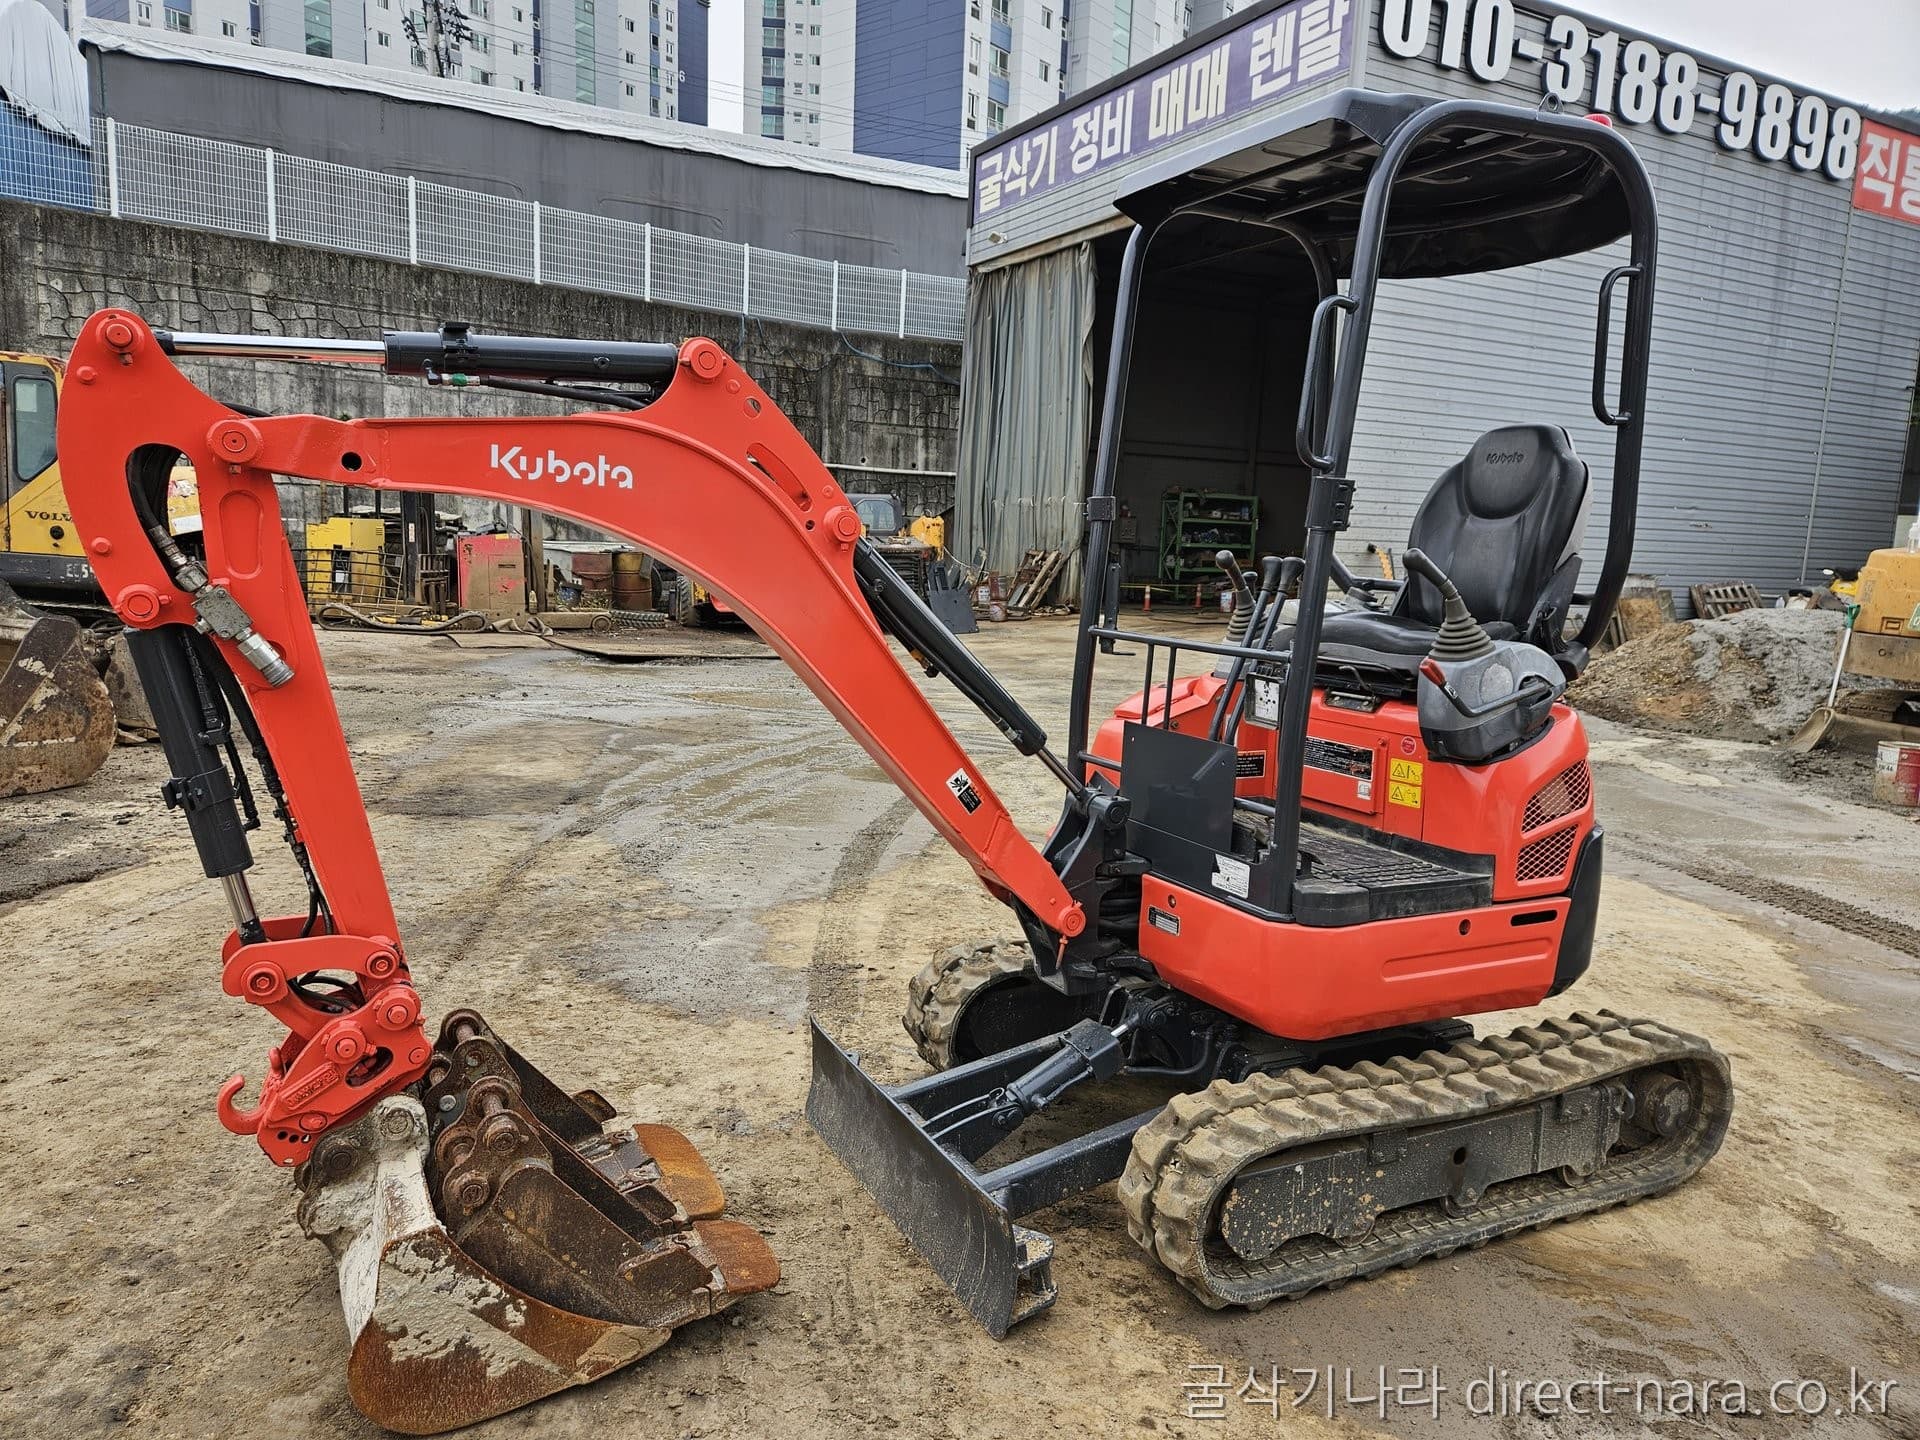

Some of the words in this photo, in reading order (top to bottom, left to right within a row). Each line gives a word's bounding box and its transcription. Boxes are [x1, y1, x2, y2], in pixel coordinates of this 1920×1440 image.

[978, 127, 1057, 214] 굴삭기
[1070, 90, 1133, 175] 정비
[1148, 42, 1231, 141] 매매
[1249, 0, 1350, 101] 렌탈
[1380, 0, 1861, 180] 010-3188-9898
[490, 443, 635, 490] Kubota
[1486, 451, 1525, 465] Kubota
[25, 510, 72, 523] VOLV
